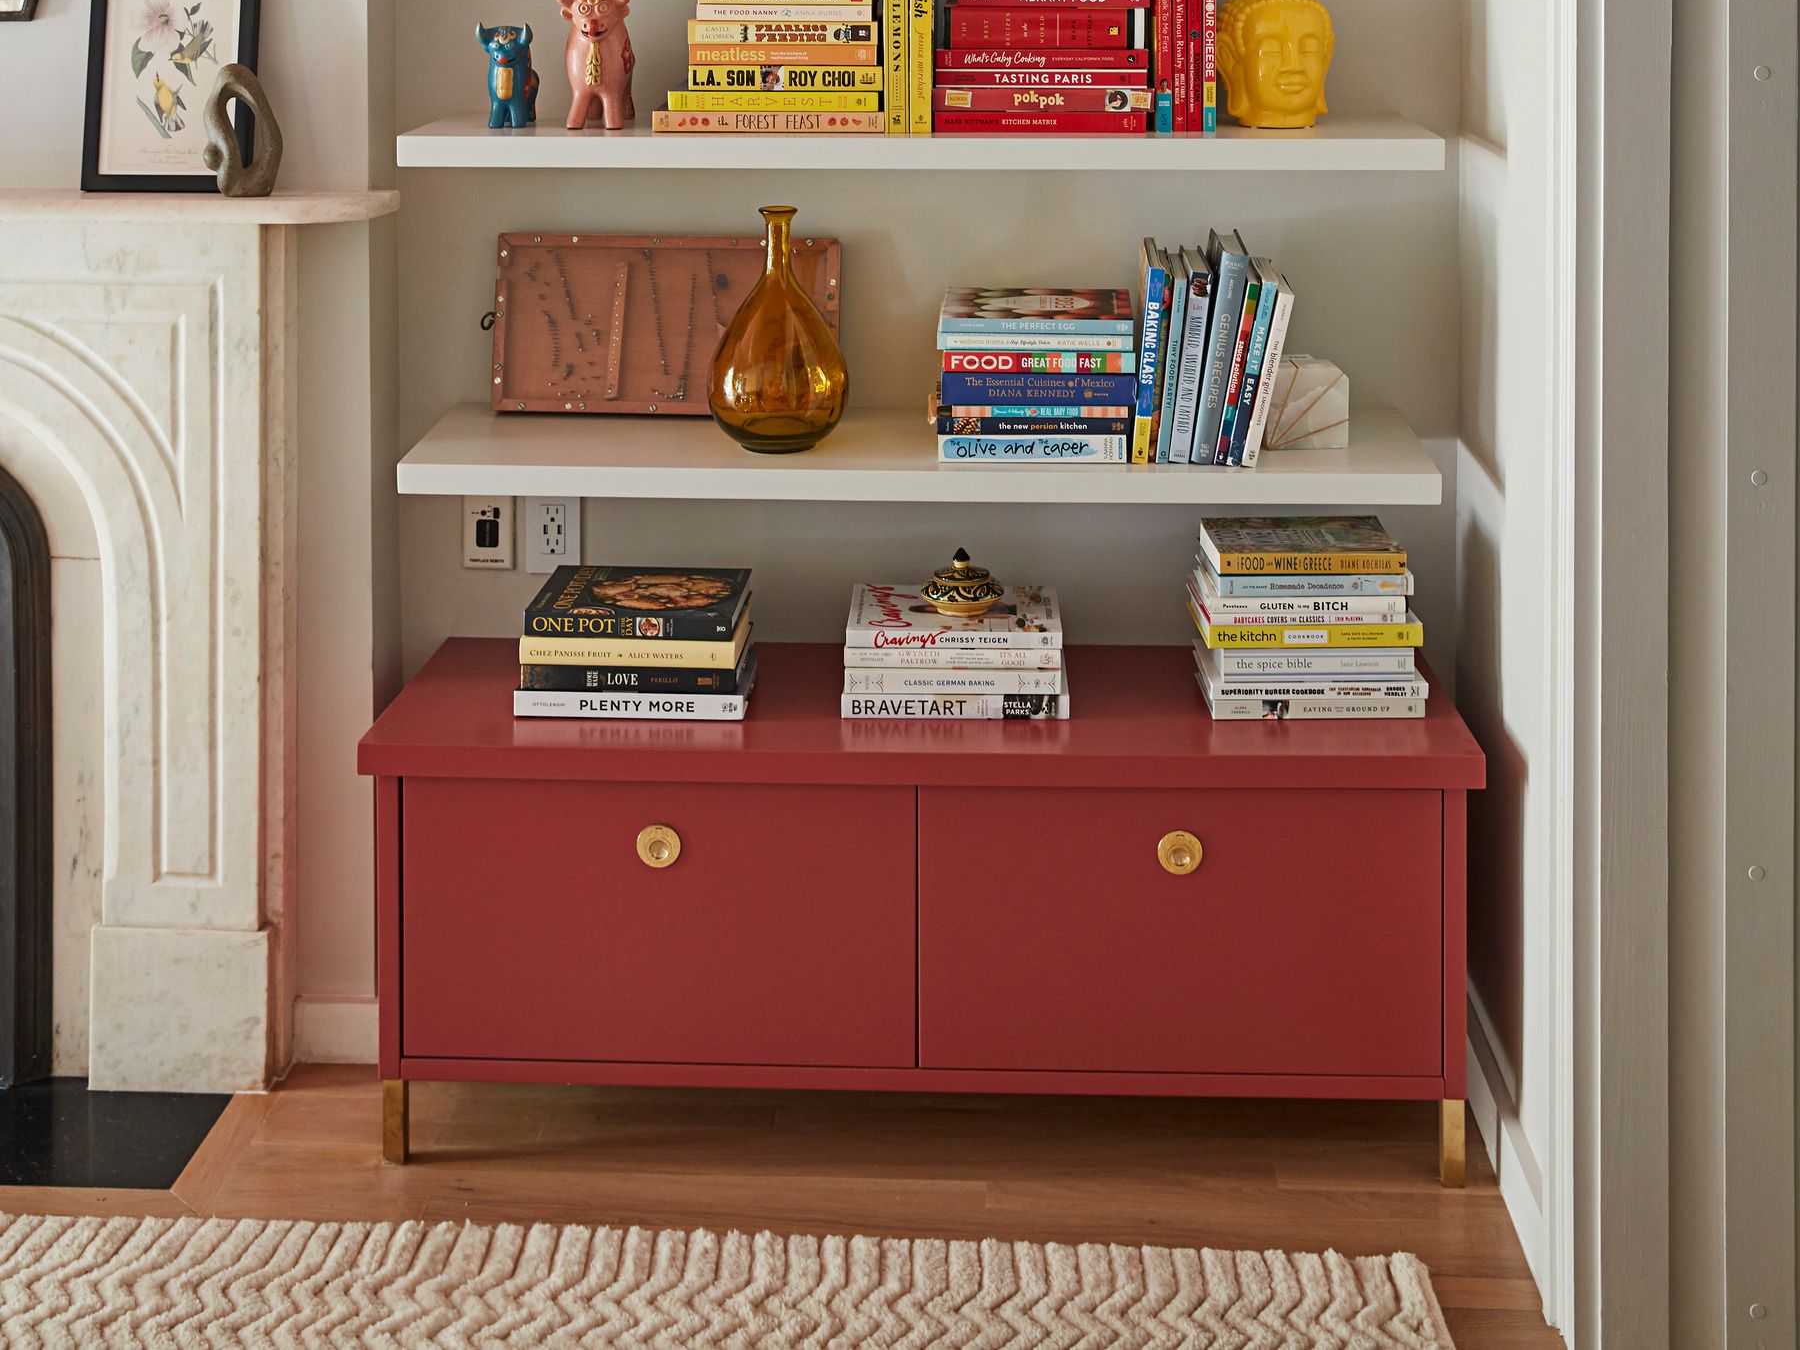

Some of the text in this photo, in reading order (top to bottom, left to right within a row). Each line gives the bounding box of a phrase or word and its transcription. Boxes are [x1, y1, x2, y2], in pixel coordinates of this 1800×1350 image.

[696, 48, 766, 61] meatless
[1206, 31, 1214, 77] CHEESE
[692, 70, 856, 87] L.A. SON ROY CHOI
[994, 74, 1093, 83] TASTING PARIS
[735, 115, 822, 129] FOREST FEAST
[1001, 322, 1017, 330] THE
[1019, 322, 1055, 330] PERFECT
[1141, 302, 1160, 385] BAKING CLASS
[951, 355, 1102, 369] FOOD GREAT FOOD FAST
[1207, 314, 1231, 409] GENIUS RECIPES
[1243, 326, 1264, 405] MAKE IT EASY
[965, 377, 1115, 388] The Essential Cuisines of Mexico
[989, 389, 1075, 398] DIANA KENNEDY
[999, 422, 1011, 430] the
[1030, 422, 1058, 431] persian
[1060, 422, 1087, 430] kitchen
[1260, 602, 1348, 611] GLUTEN BITCH
[532, 617, 616, 633] ONE POT
[874, 630, 949, 649] Cravings
[1218, 631, 1238, 641] the
[1240, 630, 1276, 641] kitchn
[1236, 659, 1313, 671] the spice bible
[607, 673, 639, 685] LOVE
[579, 700, 695, 713] PLENTY MORE
[851, 700, 967, 715] BRAVETART
